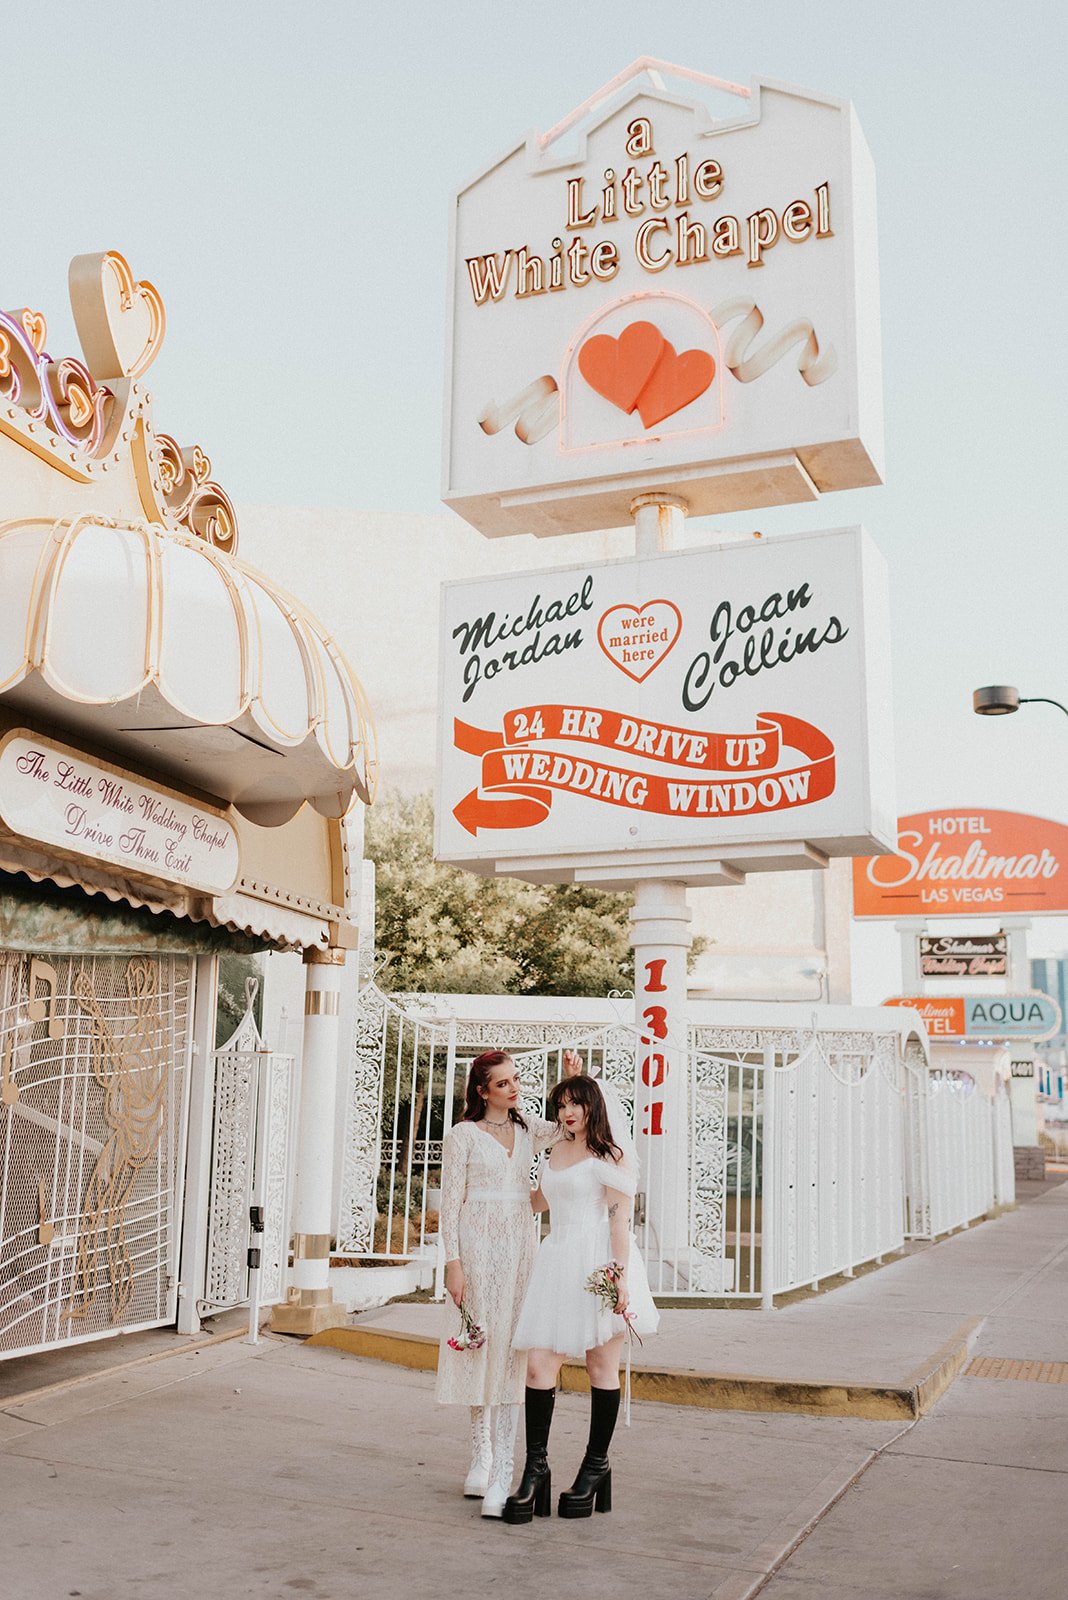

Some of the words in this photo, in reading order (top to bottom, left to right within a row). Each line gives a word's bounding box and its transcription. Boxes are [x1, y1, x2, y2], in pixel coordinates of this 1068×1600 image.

[625, 117, 655, 158] a
[566, 153, 725, 231] Little
[465, 237, 620, 306] White
[634, 182, 835, 272] Chapel
[452, 575, 594, 655] Michael
[609, 628, 669, 648] married
[621, 614, 655, 630] were
[710, 582, 813, 663] Joan
[462, 628, 584, 703] Jordan
[622, 647, 655, 663] here
[682, 615, 850, 712] Collins
[513, 710, 546, 740] 24
[560, 708, 603, 741] HR
[614, 719, 708, 764] DRIVE
[725, 737, 767, 767] UP
[16, 750, 50, 783] The
[54, 761, 94, 799] Little
[98, 778, 135, 815] White
[138, 795, 187, 842] Wedding
[191, 815, 229, 852] Chapel
[502, 754, 649, 806] WEDDING
[667, 770, 813, 813] WINDOW
[65, 802, 113, 847] Drive
[119, 828, 159, 863] Thru
[164, 838, 192, 873] Exit
[929, 817, 991, 835] HOTEL
[866, 830, 1060, 888] Shalimar
[921, 888, 949, 903] LAS
[952, 887, 1004, 903] VEGAS
[923, 1018, 956, 1033] TEL
[971, 1002, 1044, 1024] AQUA
[640, 959, 669, 1136] 1301
